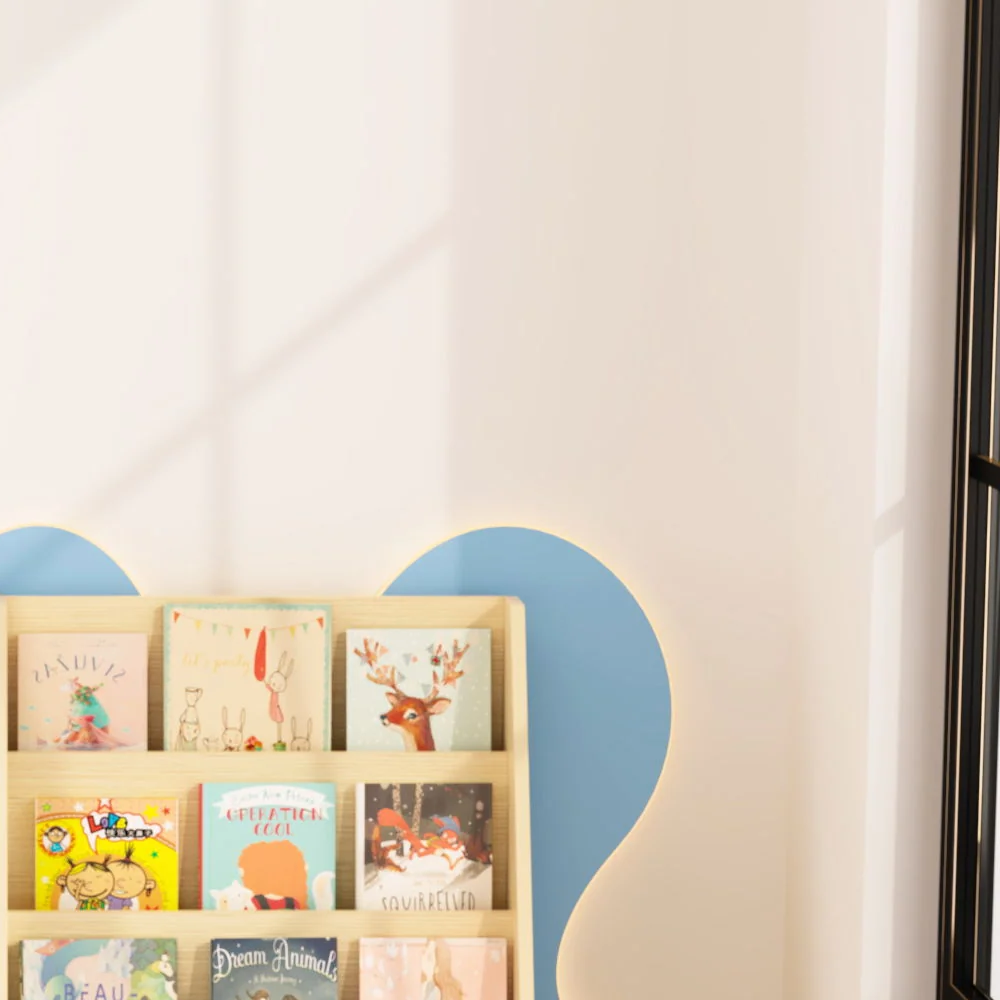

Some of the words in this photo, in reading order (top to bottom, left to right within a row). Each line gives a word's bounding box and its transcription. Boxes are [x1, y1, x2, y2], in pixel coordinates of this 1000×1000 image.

[253, 822, 295, 837] COOL
[212, 943, 269, 984] Dream
[271, 937, 338, 982] Animals
